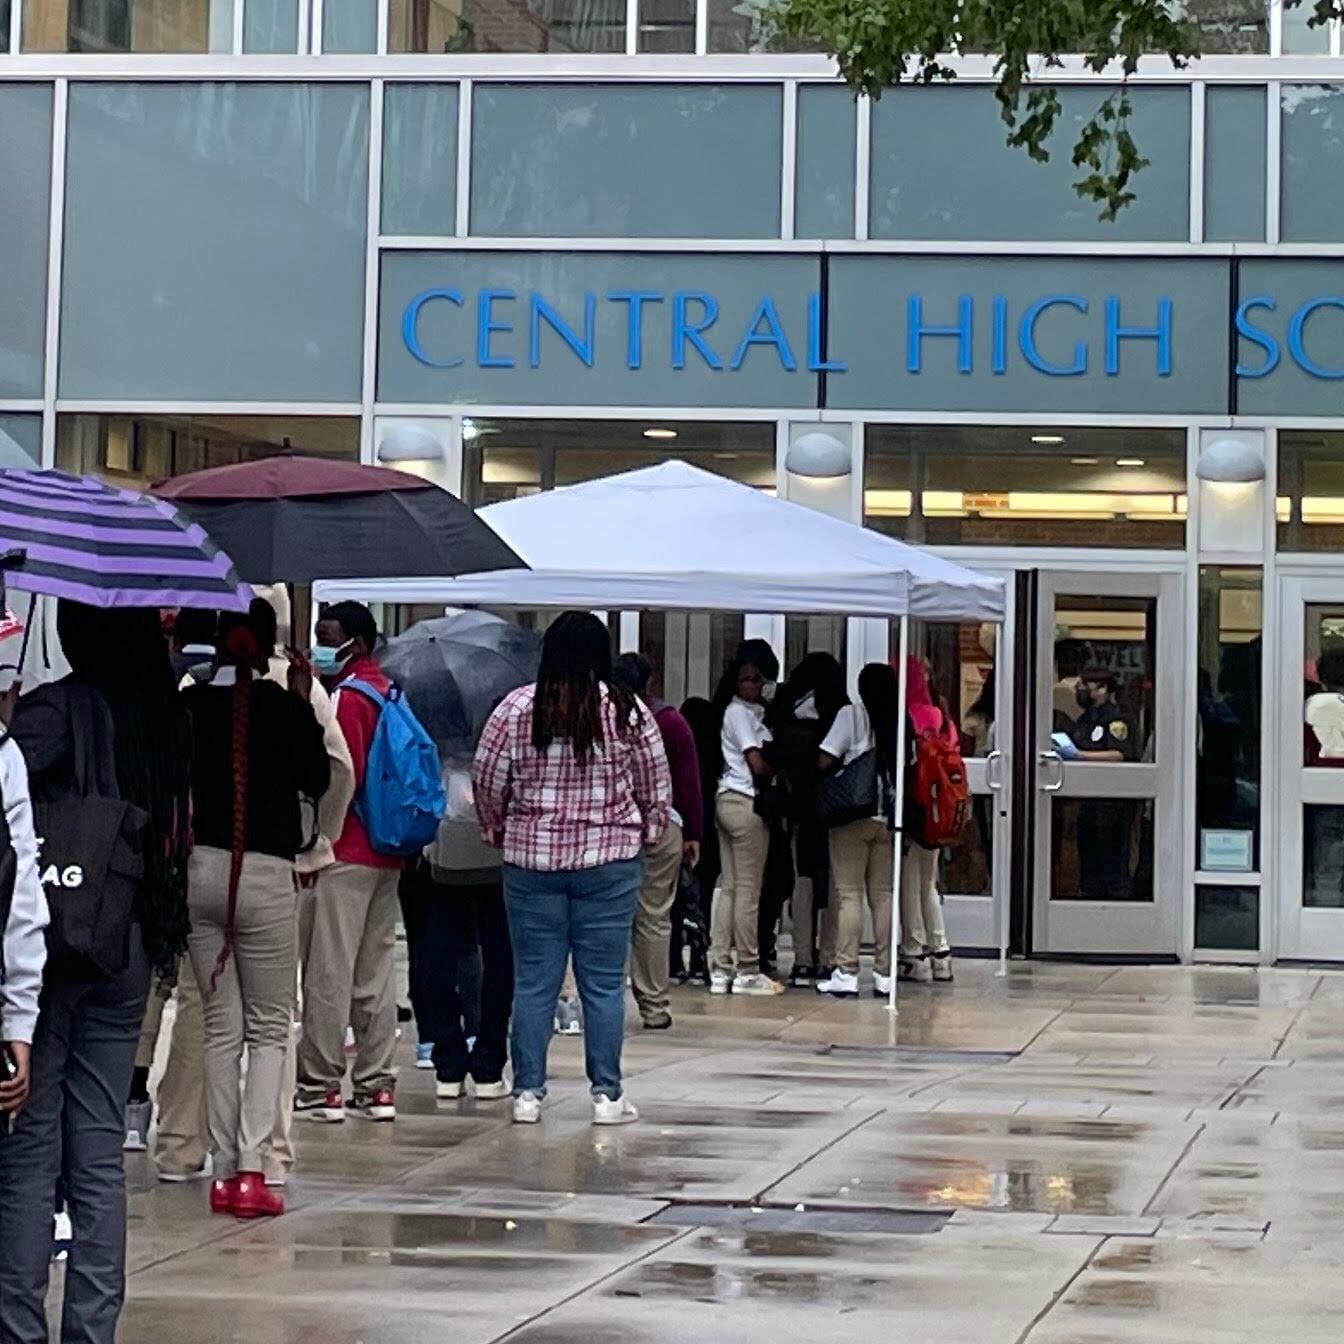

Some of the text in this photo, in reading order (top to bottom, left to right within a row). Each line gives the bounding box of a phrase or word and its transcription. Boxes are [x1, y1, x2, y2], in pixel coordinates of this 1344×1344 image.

[400, 286, 849, 374] CENTRAL
[905, 292, 1174, 377] HIGH
[35, 863, 84, 888] AG
